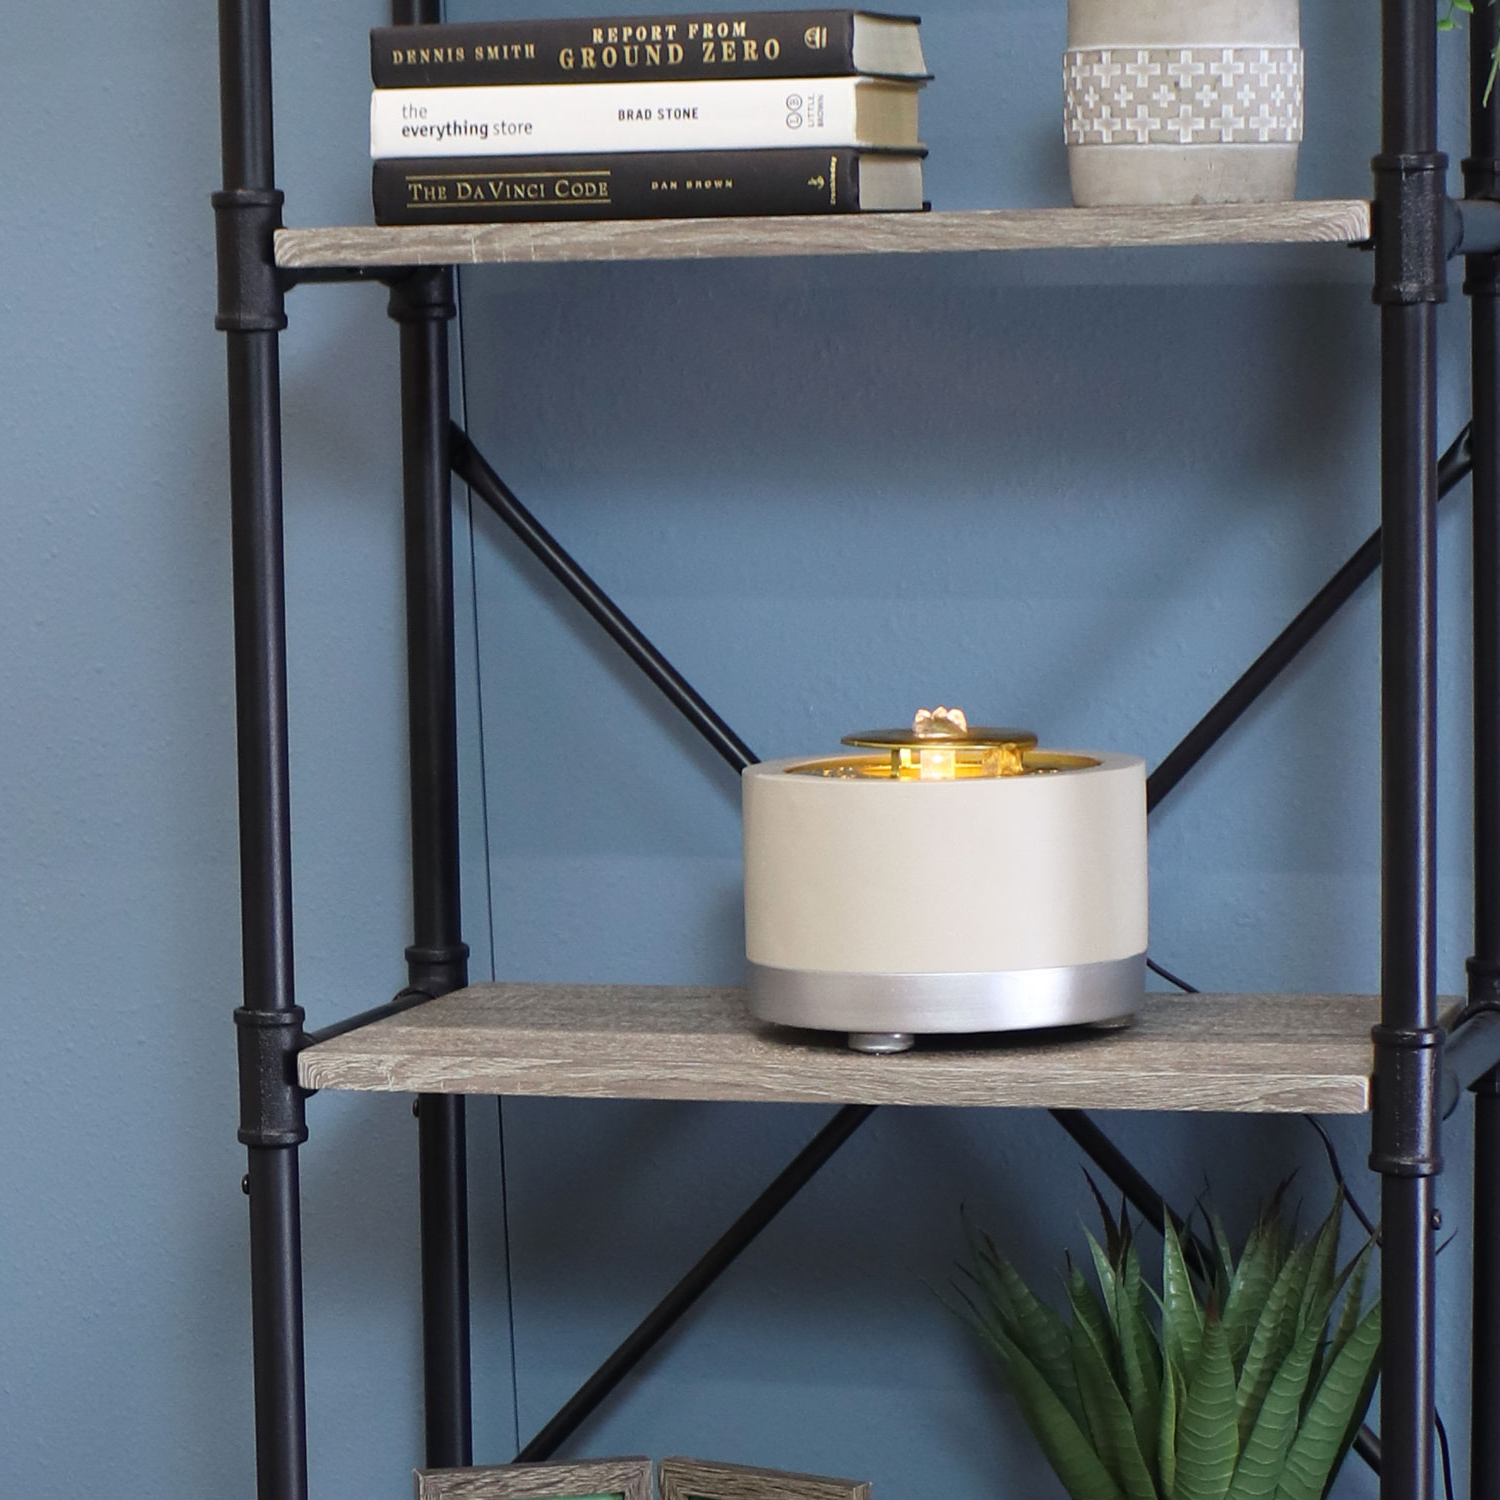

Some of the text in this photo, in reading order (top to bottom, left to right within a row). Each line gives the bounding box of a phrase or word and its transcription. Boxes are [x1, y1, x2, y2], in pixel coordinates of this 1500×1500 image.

[593, 21, 746, 43] REPORT FROM
[393, 43, 535, 64] DENNIS SMITH
[559, 38, 780, 69] GROUND ZERO
[402, 103, 428, 119] the
[618, 106, 699, 121] BRAD STONE
[401, 120, 533, 141] everything store
[651, 179, 733, 190] DAN BROWN
